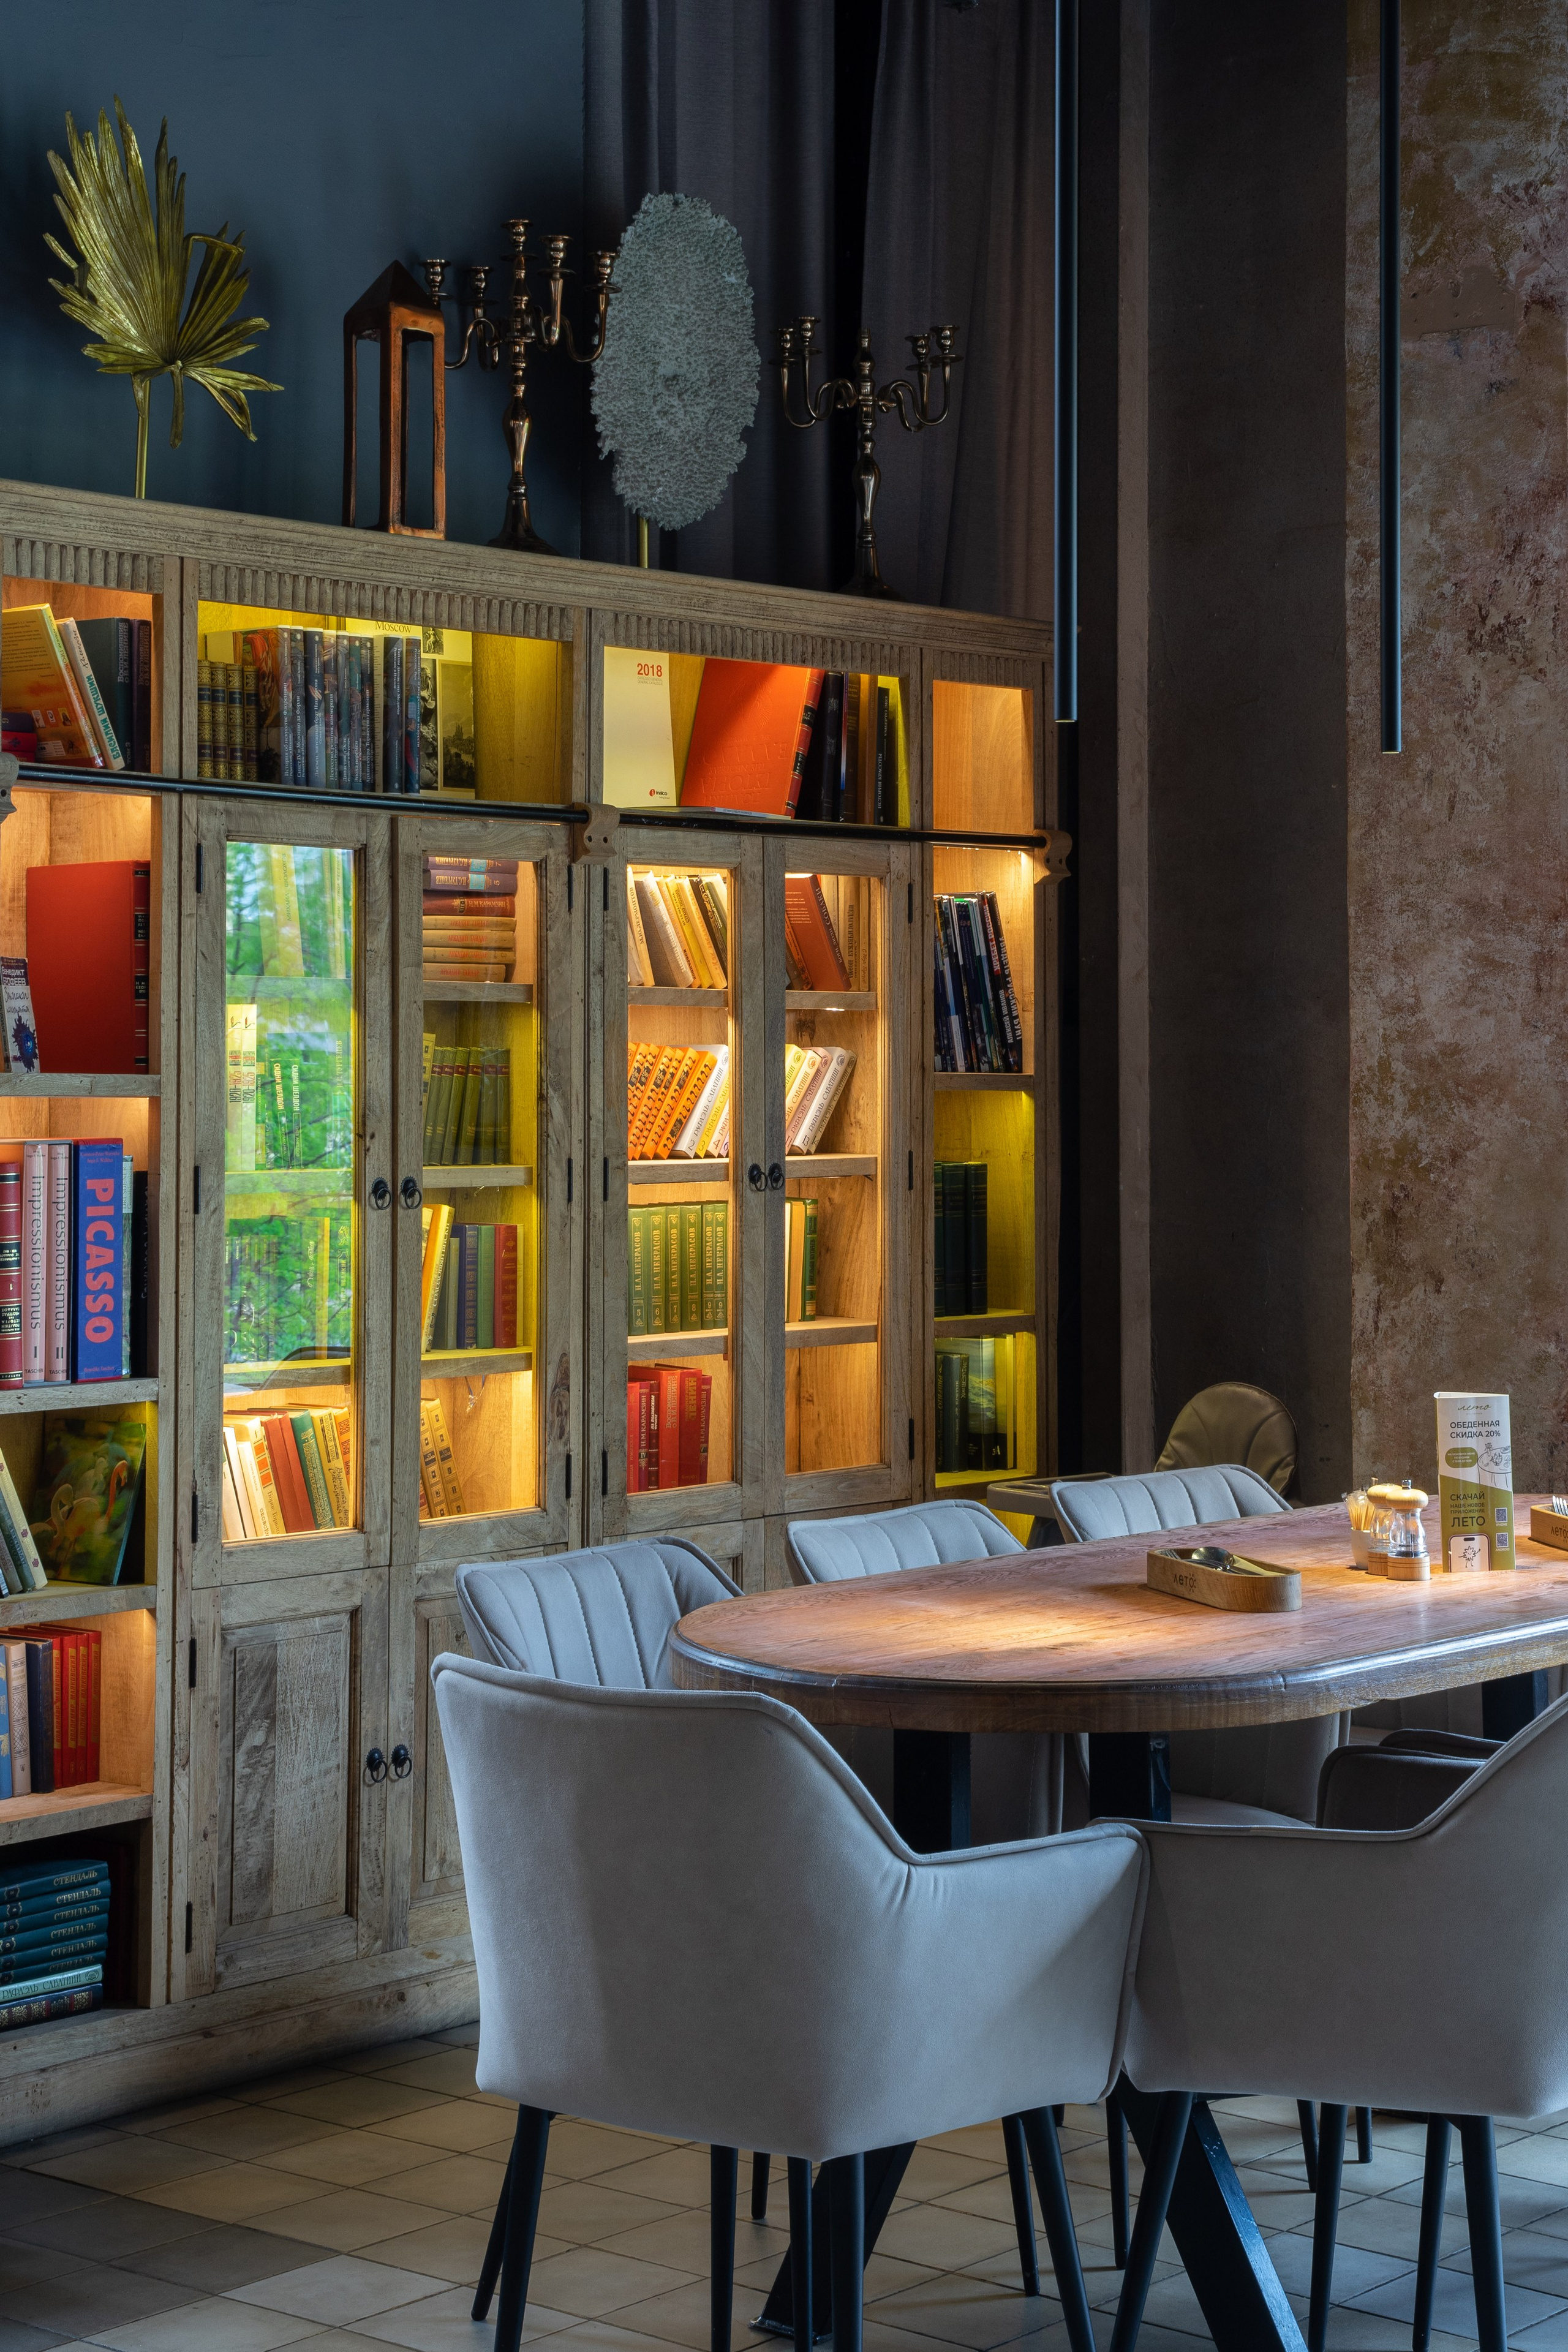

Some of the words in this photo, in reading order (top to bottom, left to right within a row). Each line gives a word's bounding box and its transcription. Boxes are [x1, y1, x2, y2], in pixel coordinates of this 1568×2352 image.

[375, 621, 412, 634] Moscow
[637, 663, 662, 677] 2018
[86, 675, 107, 715] ШУКШИН
[100, 716, 121, 760] ВАСИЛИЙ
[281, 853, 289, 887] ШОЛОХОВ
[673, 893, 685, 926] ПУТЕШЕСТВИЕ
[680, 907, 690, 924] СТРАНУ
[815, 888, 831, 925] СОБАКИ
[983, 905, 994, 939] РОССИИ
[684, 949, 696, 980] ИЗБРАННОЕ
[990, 939, 1000, 975] ХРЕБЕТ
[1, 967, 24, 977] Венедикт
[2, 978, 26, 986] ЕРОФЕЕВ
[998, 989, 1008, 1014] ИВАНОВ
[999, 937, 1010, 976] УВИДЕТЬ
[1006, 976, 1019, 1020] РУССКИЙ
[1013, 1018, 1022, 1041] БУНТ
[1002, 1016, 1014, 1043] АЛЕКСЕЙ
[334, 1039, 344, 1075] ТУРГЕНЕВ
[276, 1084, 284, 1109] ШЕЛДОН
[792, 1071, 810, 1104] САБАТИНИ
[809, 1102, 824, 1133] РАФАЭЛЬ
[822, 1068, 839, 1100] САБАТИНИ
[688, 1140, 696, 1151] 2
[693, 1104, 709, 1137] РАФАЭЛЬ
[707, 1068, 724, 1103] САБАТИНИ
[791, 1104, 807, 1134] РАФАЭЛЬ
[805, 1069, 823, 1102] САБАТИНИ
[818, 1104, 834, 1134] РАФАЭЛЬ
[833, 1069, 850, 1102] САБАТИНИ
[698, 1140, 706, 1152] 3
[704, 1106, 721, 1137] РАФАЭЛЬ
[713, 1139, 721, 1150] 4
[28, 1176, 45, 1330] Impressionismus
[52, 1177, 68, 1330] Impressionismus
[85, 1178, 115, 1343] PICASSO
[432, 1254, 445, 1307] СОЛОДОВЫЙ
[441, 1222, 450, 1251] ВИСКИ
[339, 1259, 347, 1286] ВЕЛИКИЙ
[34, 1346, 37, 1358] I
[56, 1347, 64, 1359] II
[688, 1378, 697, 1420] ЛЕНИН
[1449, 1420, 1500, 1430] ОБЕДЕННАЯ
[1450, 1431, 1483, 1439] СКИДКА
[1485, 1430, 1501, 1438] 20%
[1450, 1491, 1486, 1502] СКАЧАЙ
[1450, 1515, 1486, 1528] ЛЕТО
[53, 1870, 97, 1886] СТЕНДАЛЬ
[56, 1888, 101, 1904] СТЕНДАЛЬ
[54, 1905, 99, 1921] СТЕНДАЛЬ
[50, 1922, 96, 1939] СТЕНДАЛЬ
[51, 1940, 97, 1957] СТЕНДАЛЬ
[49, 1956, 95, 1973] СТЕНДАЛЬ
[2, 1983, 39, 2000] РАФАЭЛЬ
[42, 1973, 81, 1990] САБАТИНИ
